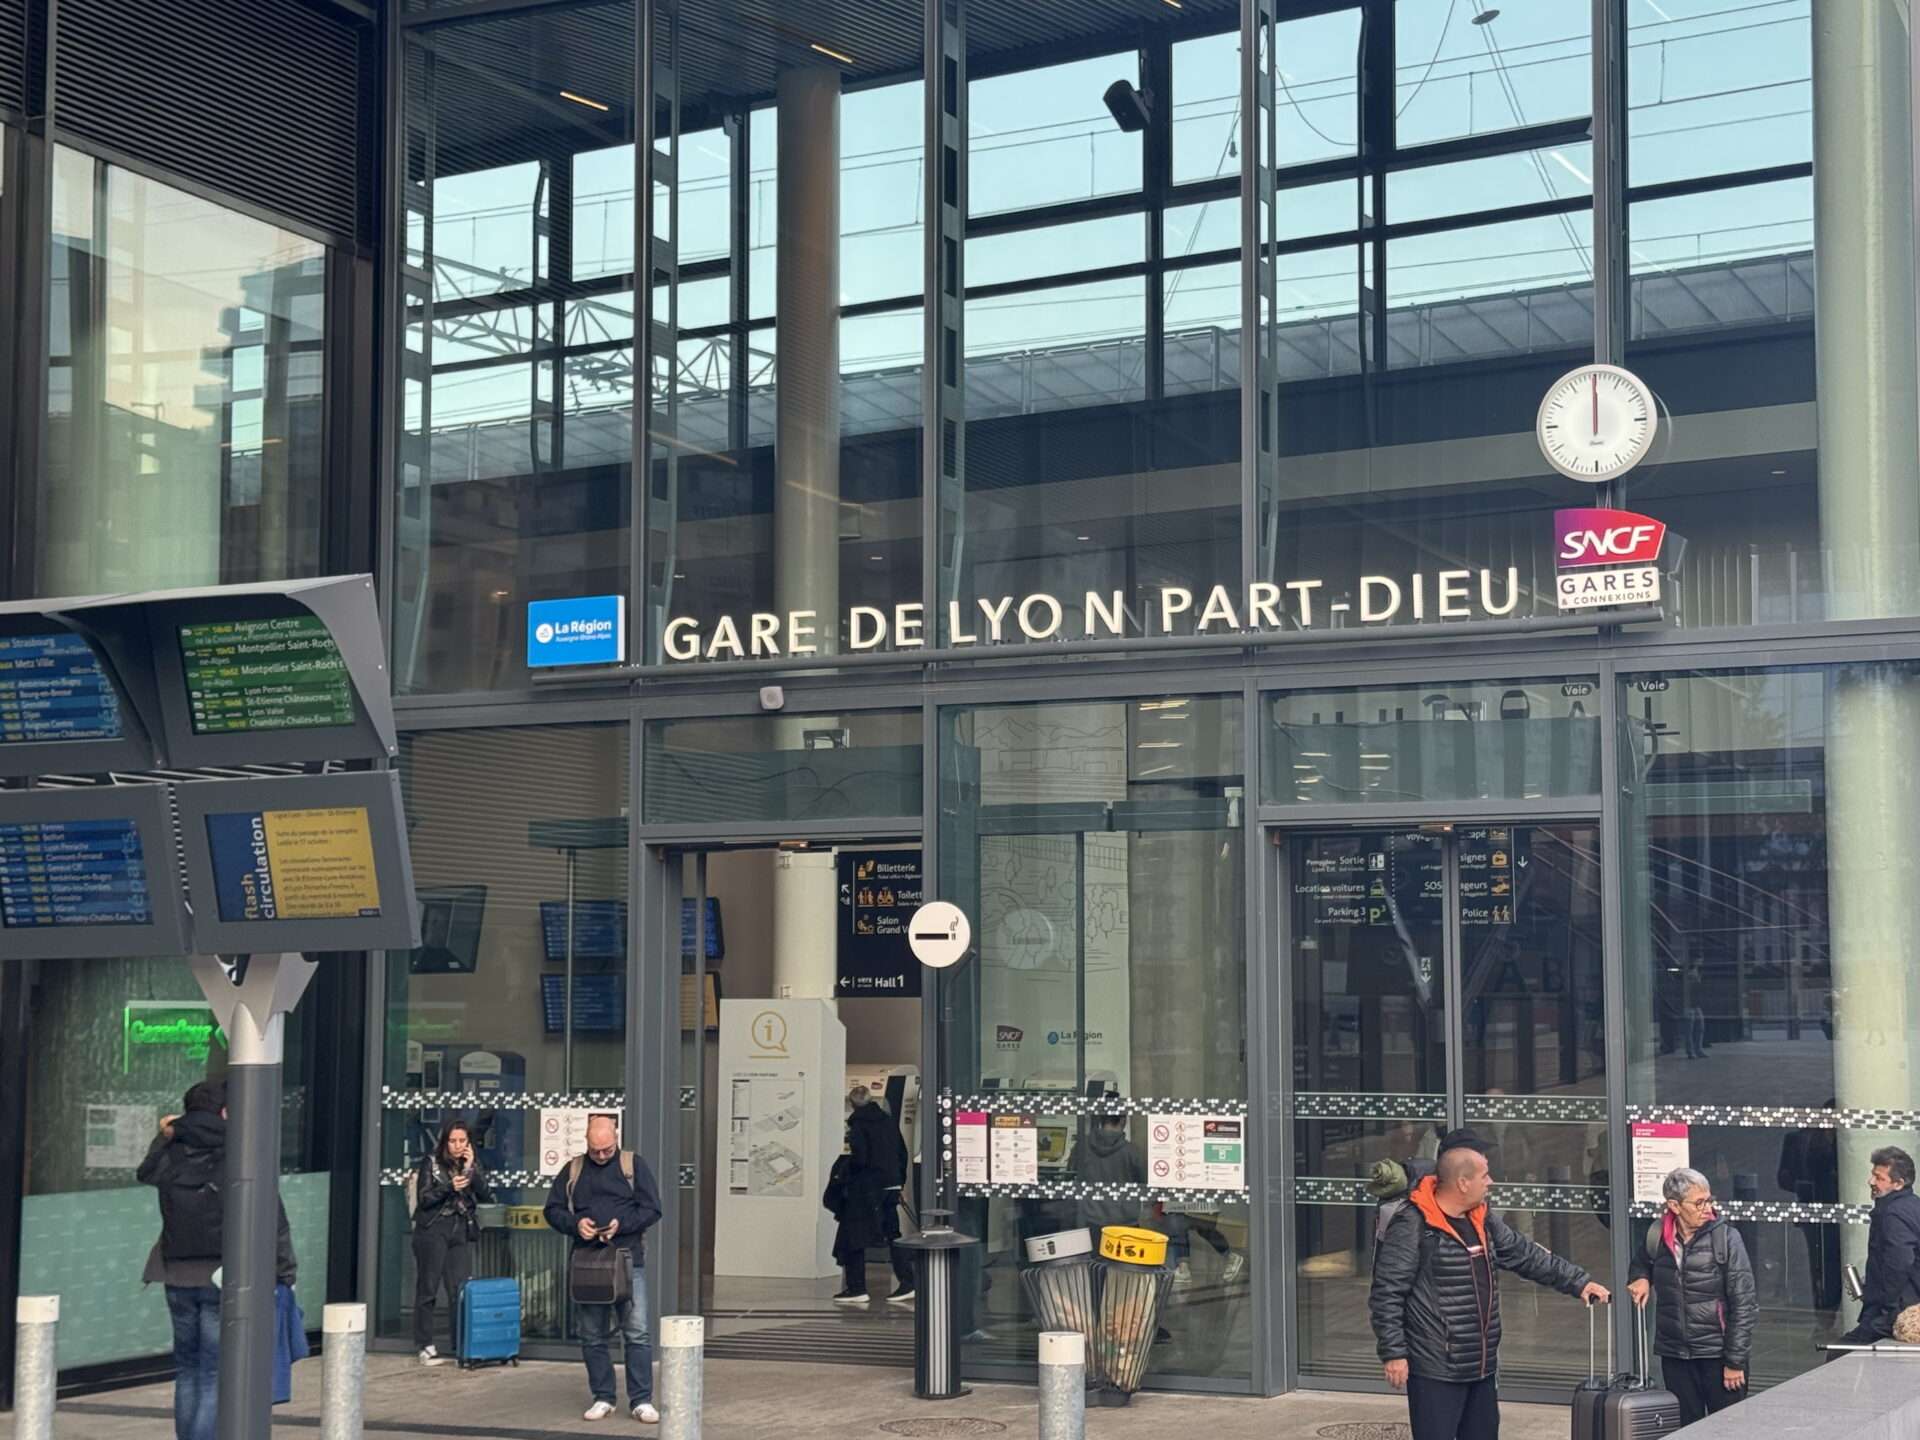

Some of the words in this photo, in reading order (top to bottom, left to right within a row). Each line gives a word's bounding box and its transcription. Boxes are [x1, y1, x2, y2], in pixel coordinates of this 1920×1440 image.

[1561, 525, 1655, 559] SNCF
[1561, 571, 1653, 594] GARES
[1574, 591, 1651, 605] CONNEXIONS
[663, 610, 817, 661] GARE
[849, 602, 924, 649] DE
[949, 590, 1123, 644] LYON
[1161, 567, 1518, 633] PART-DIEU
[235, 622, 270, 634] Avignon
[270, 619, 300, 630] Centre
[555, 622, 570, 634] La
[571, 619, 612, 633] Région
[238, 643, 286, 655] Montpellier
[287, 638, 334, 650] Saint-Roch
[241, 665, 289, 677] Montpellier
[291, 661, 337, 673] Saint-Roch
[1565, 685, 1588, 696] Voie
[1641, 680, 1666, 691] Voie
[1339, 856, 1365, 865] Sortie
[1459, 853, 1487, 865] signes
[251, 817, 275, 919] circulation
[877, 863, 916, 873] Billetterie
[1332, 883, 1365, 893] voitures
[1424, 880, 1442, 890] SOS
[242, 874, 259, 919] flash
[897, 891, 922, 900] Toilett
[1328, 906, 1359, 918] Parking
[1360, 906, 1366, 916] 3
[1462, 909, 1489, 918] Police
[877, 916, 899, 925] Salon
[877, 926, 901, 935] Grand
[875, 977, 896, 987] Hall
